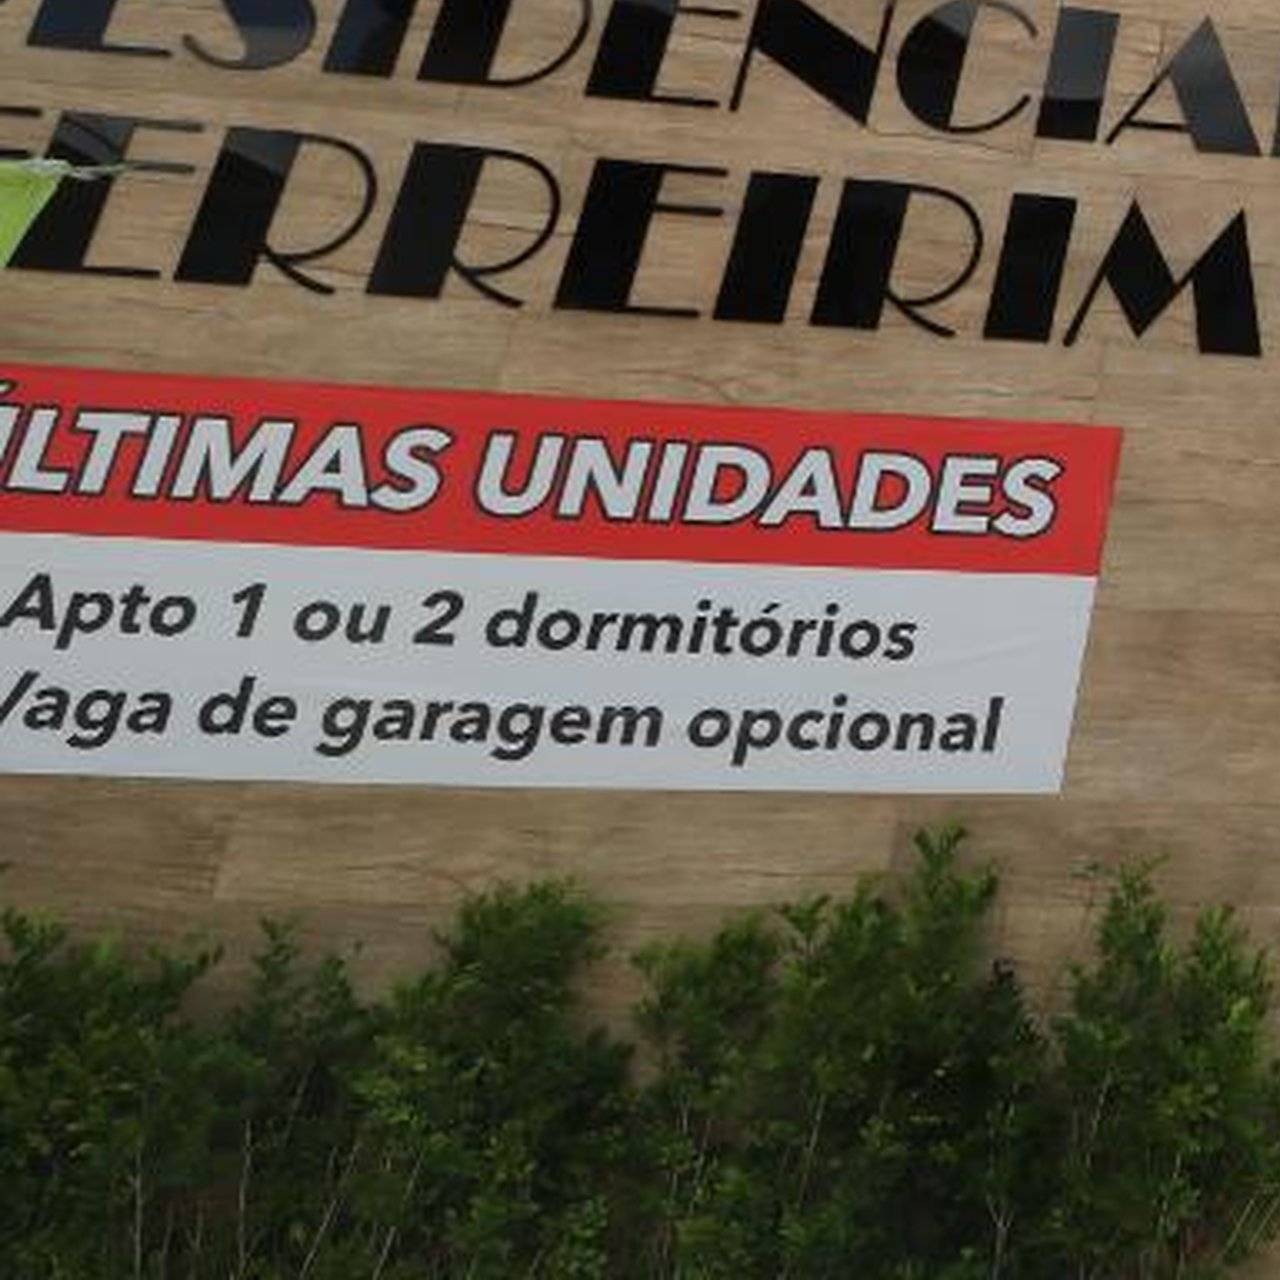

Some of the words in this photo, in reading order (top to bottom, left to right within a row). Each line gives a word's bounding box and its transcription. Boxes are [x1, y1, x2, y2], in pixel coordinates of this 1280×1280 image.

[0, 106, 1262, 357] ERREIRIM
[474, 429, 1064, 540] UNIDADES
[0, 573, 197, 651] Apto
[232, 582, 267, 638] 1
[293, 598, 392, 645] ou
[413, 589, 466, 647] 2
[486, 592, 917, 661] dormitórios
[198, 676, 298, 737] de
[314, 694, 664, 760] garagem
[688, 696, 1006, 767] opcional
